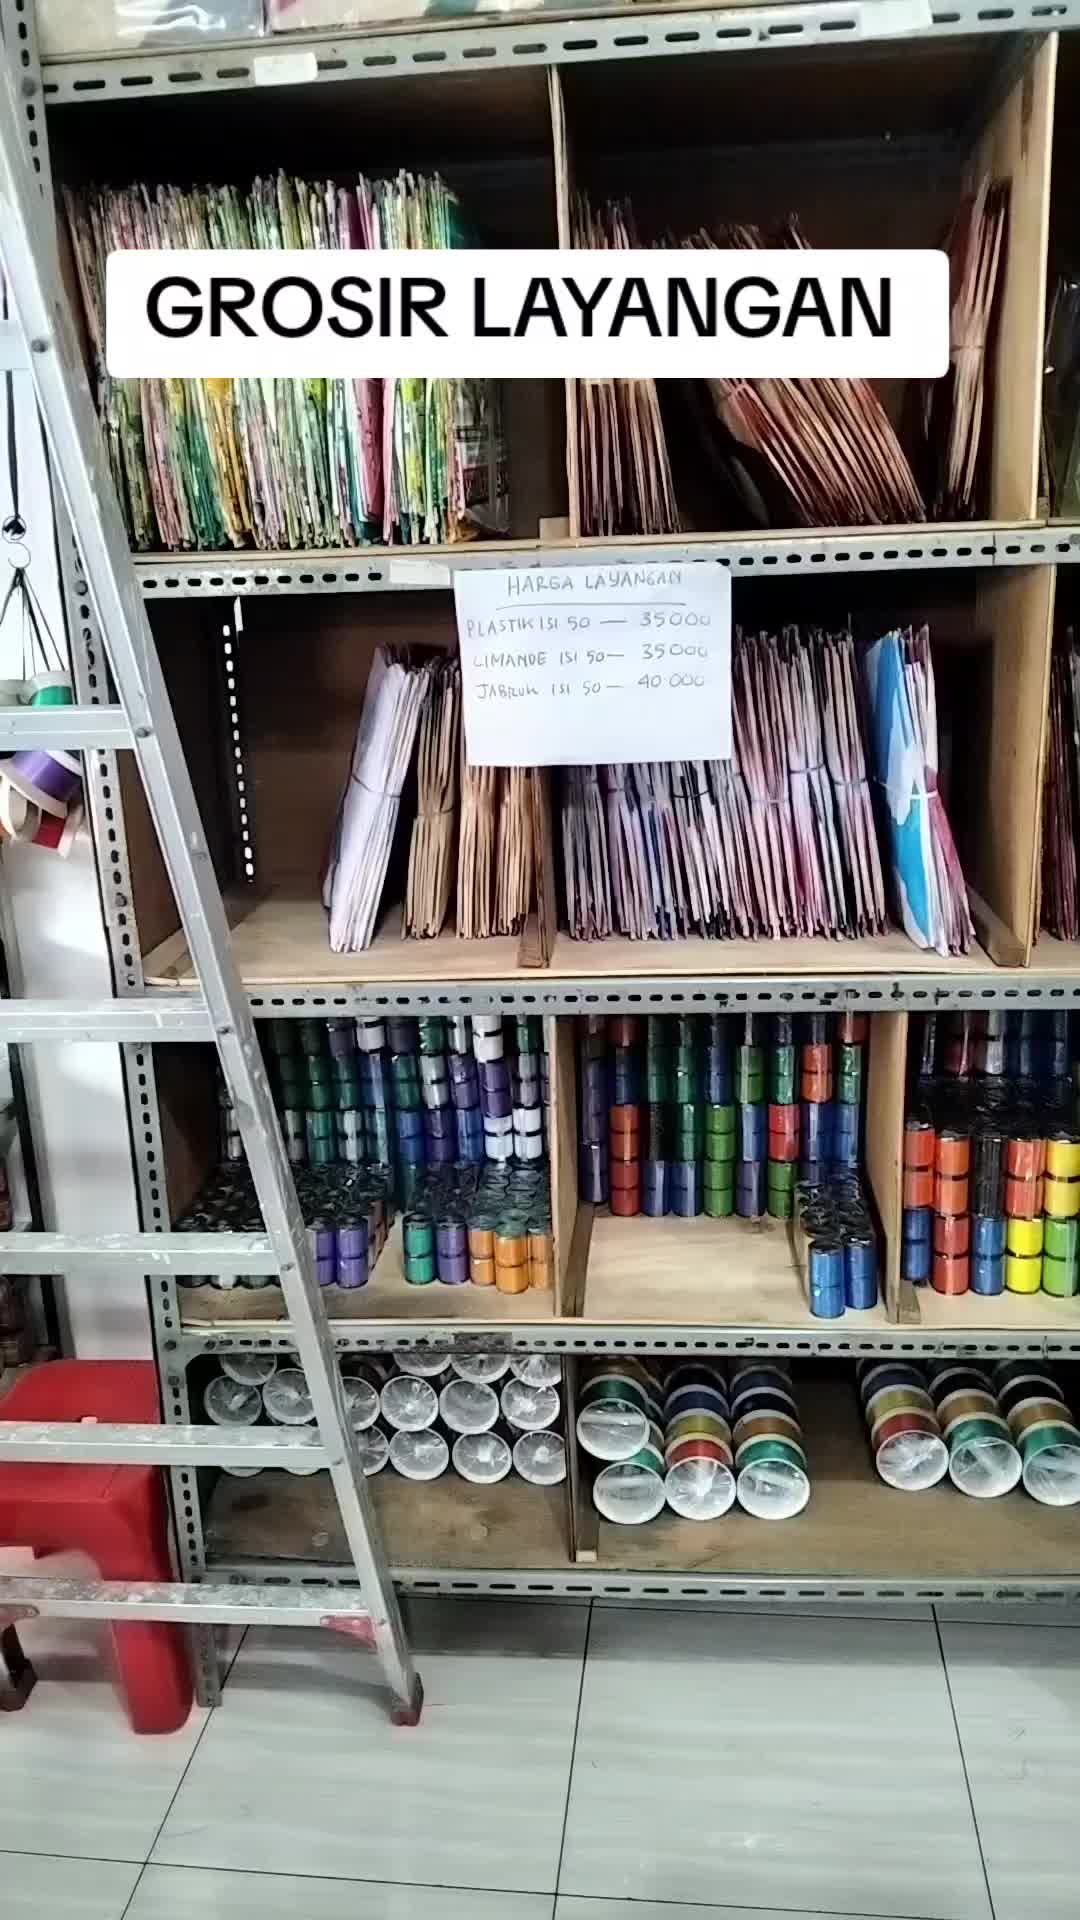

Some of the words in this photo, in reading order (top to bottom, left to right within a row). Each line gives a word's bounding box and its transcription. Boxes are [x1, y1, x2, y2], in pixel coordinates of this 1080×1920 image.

[507, 574, 575, 597] HARGA
[584, 569, 683, 591] LAYANGAN
[466, 616, 534, 639] PLASTIK
[540, 616, 559, 632] ISI
[560, 650, 578, 665] ISI
[551, 682, 571, 697] ISI
